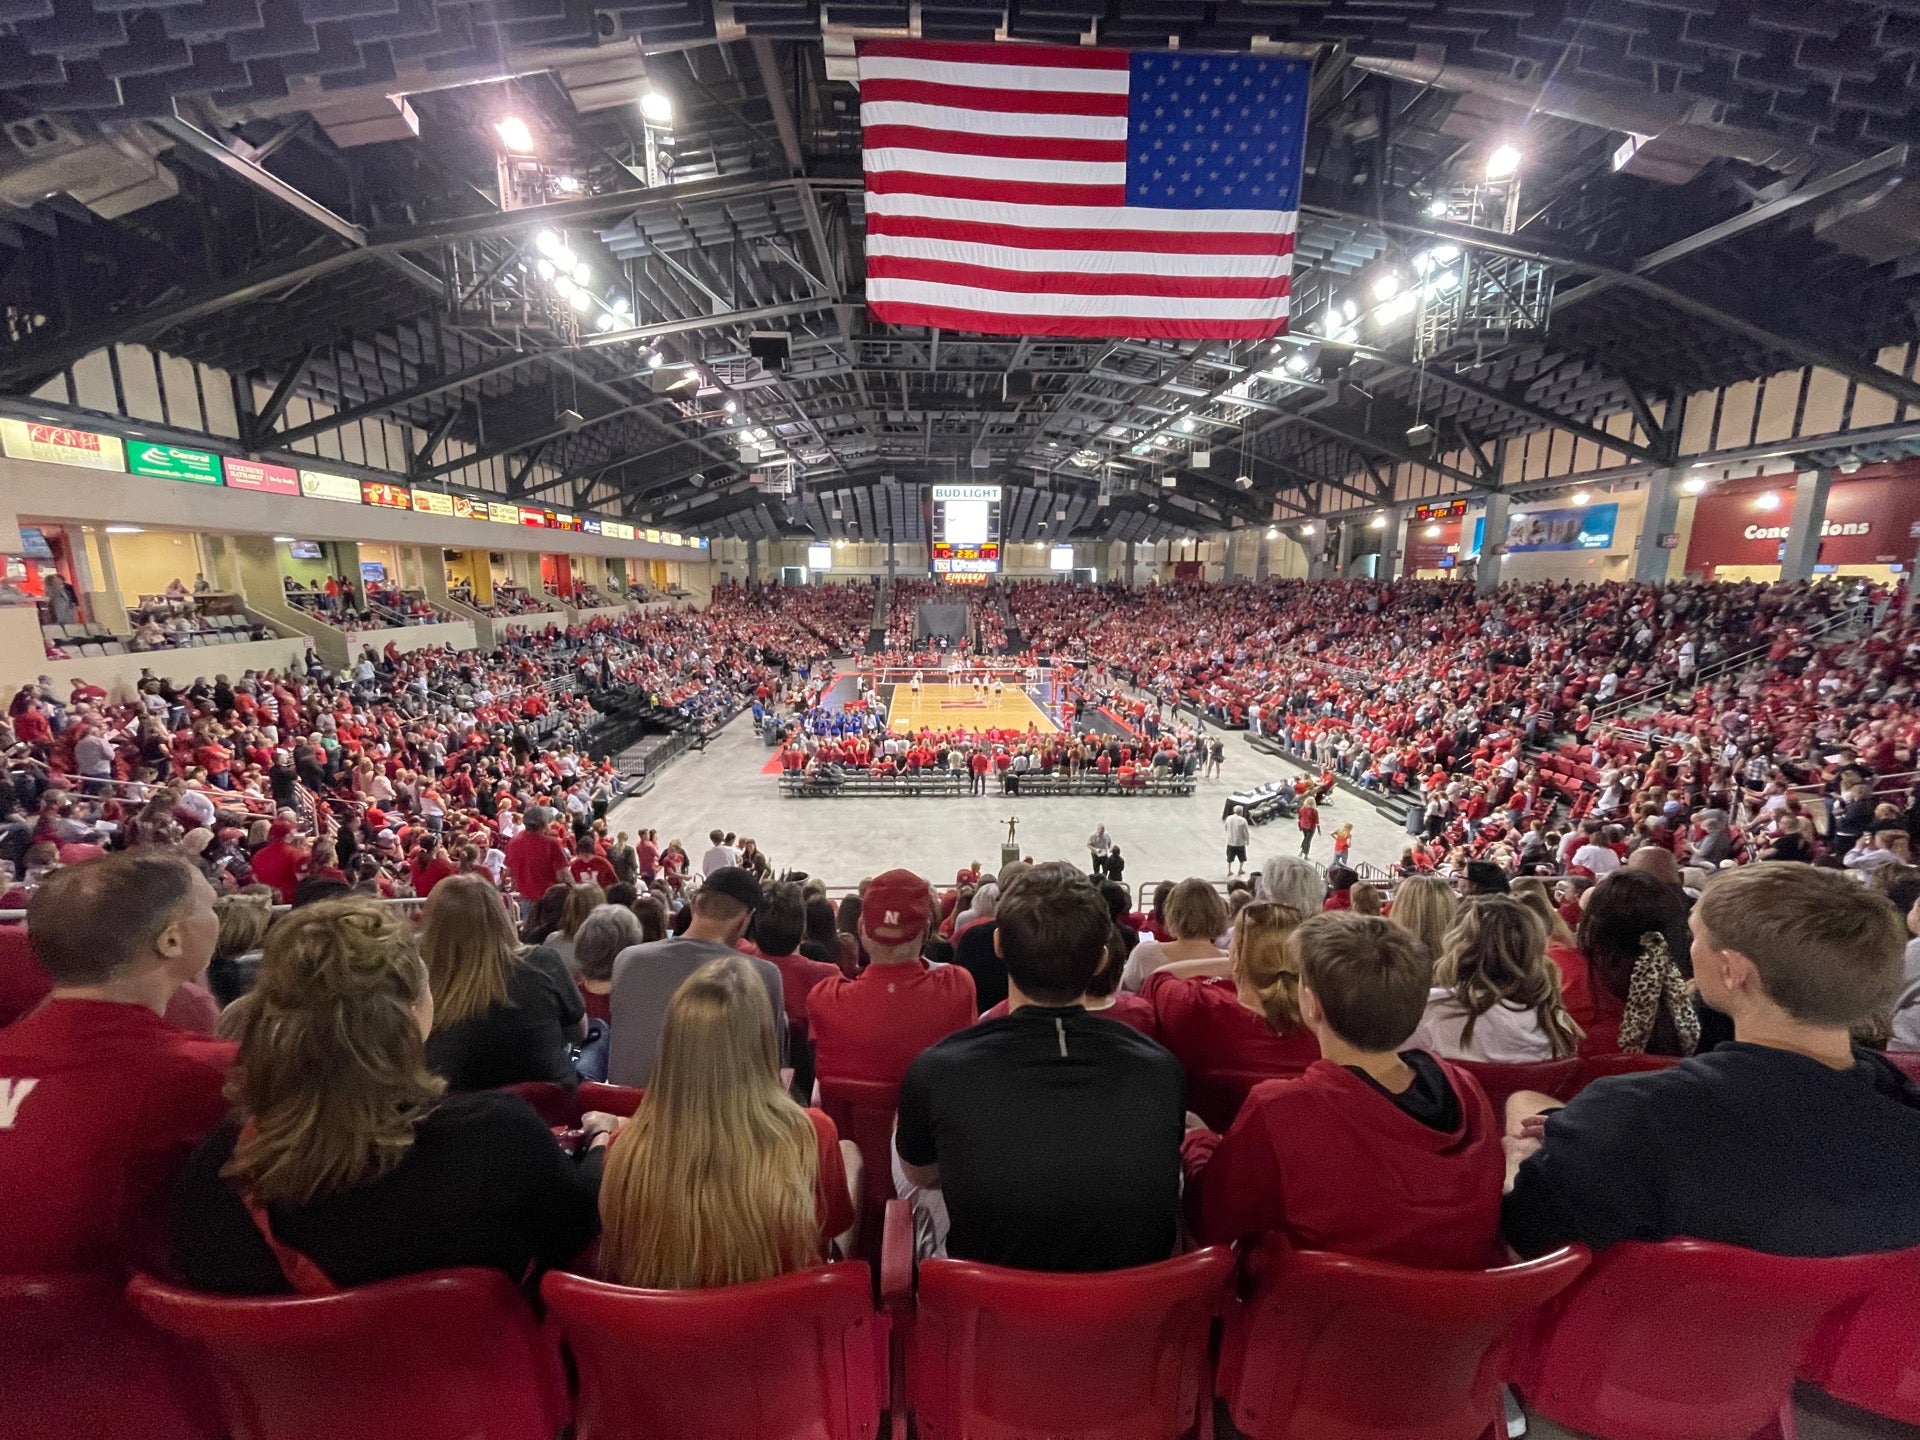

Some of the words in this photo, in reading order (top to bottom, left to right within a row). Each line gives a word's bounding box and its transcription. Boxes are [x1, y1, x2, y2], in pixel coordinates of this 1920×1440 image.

[936, 489, 960, 498] BUD
[964, 489, 998, 498] LIGHT
[884, 910, 900, 925] N
